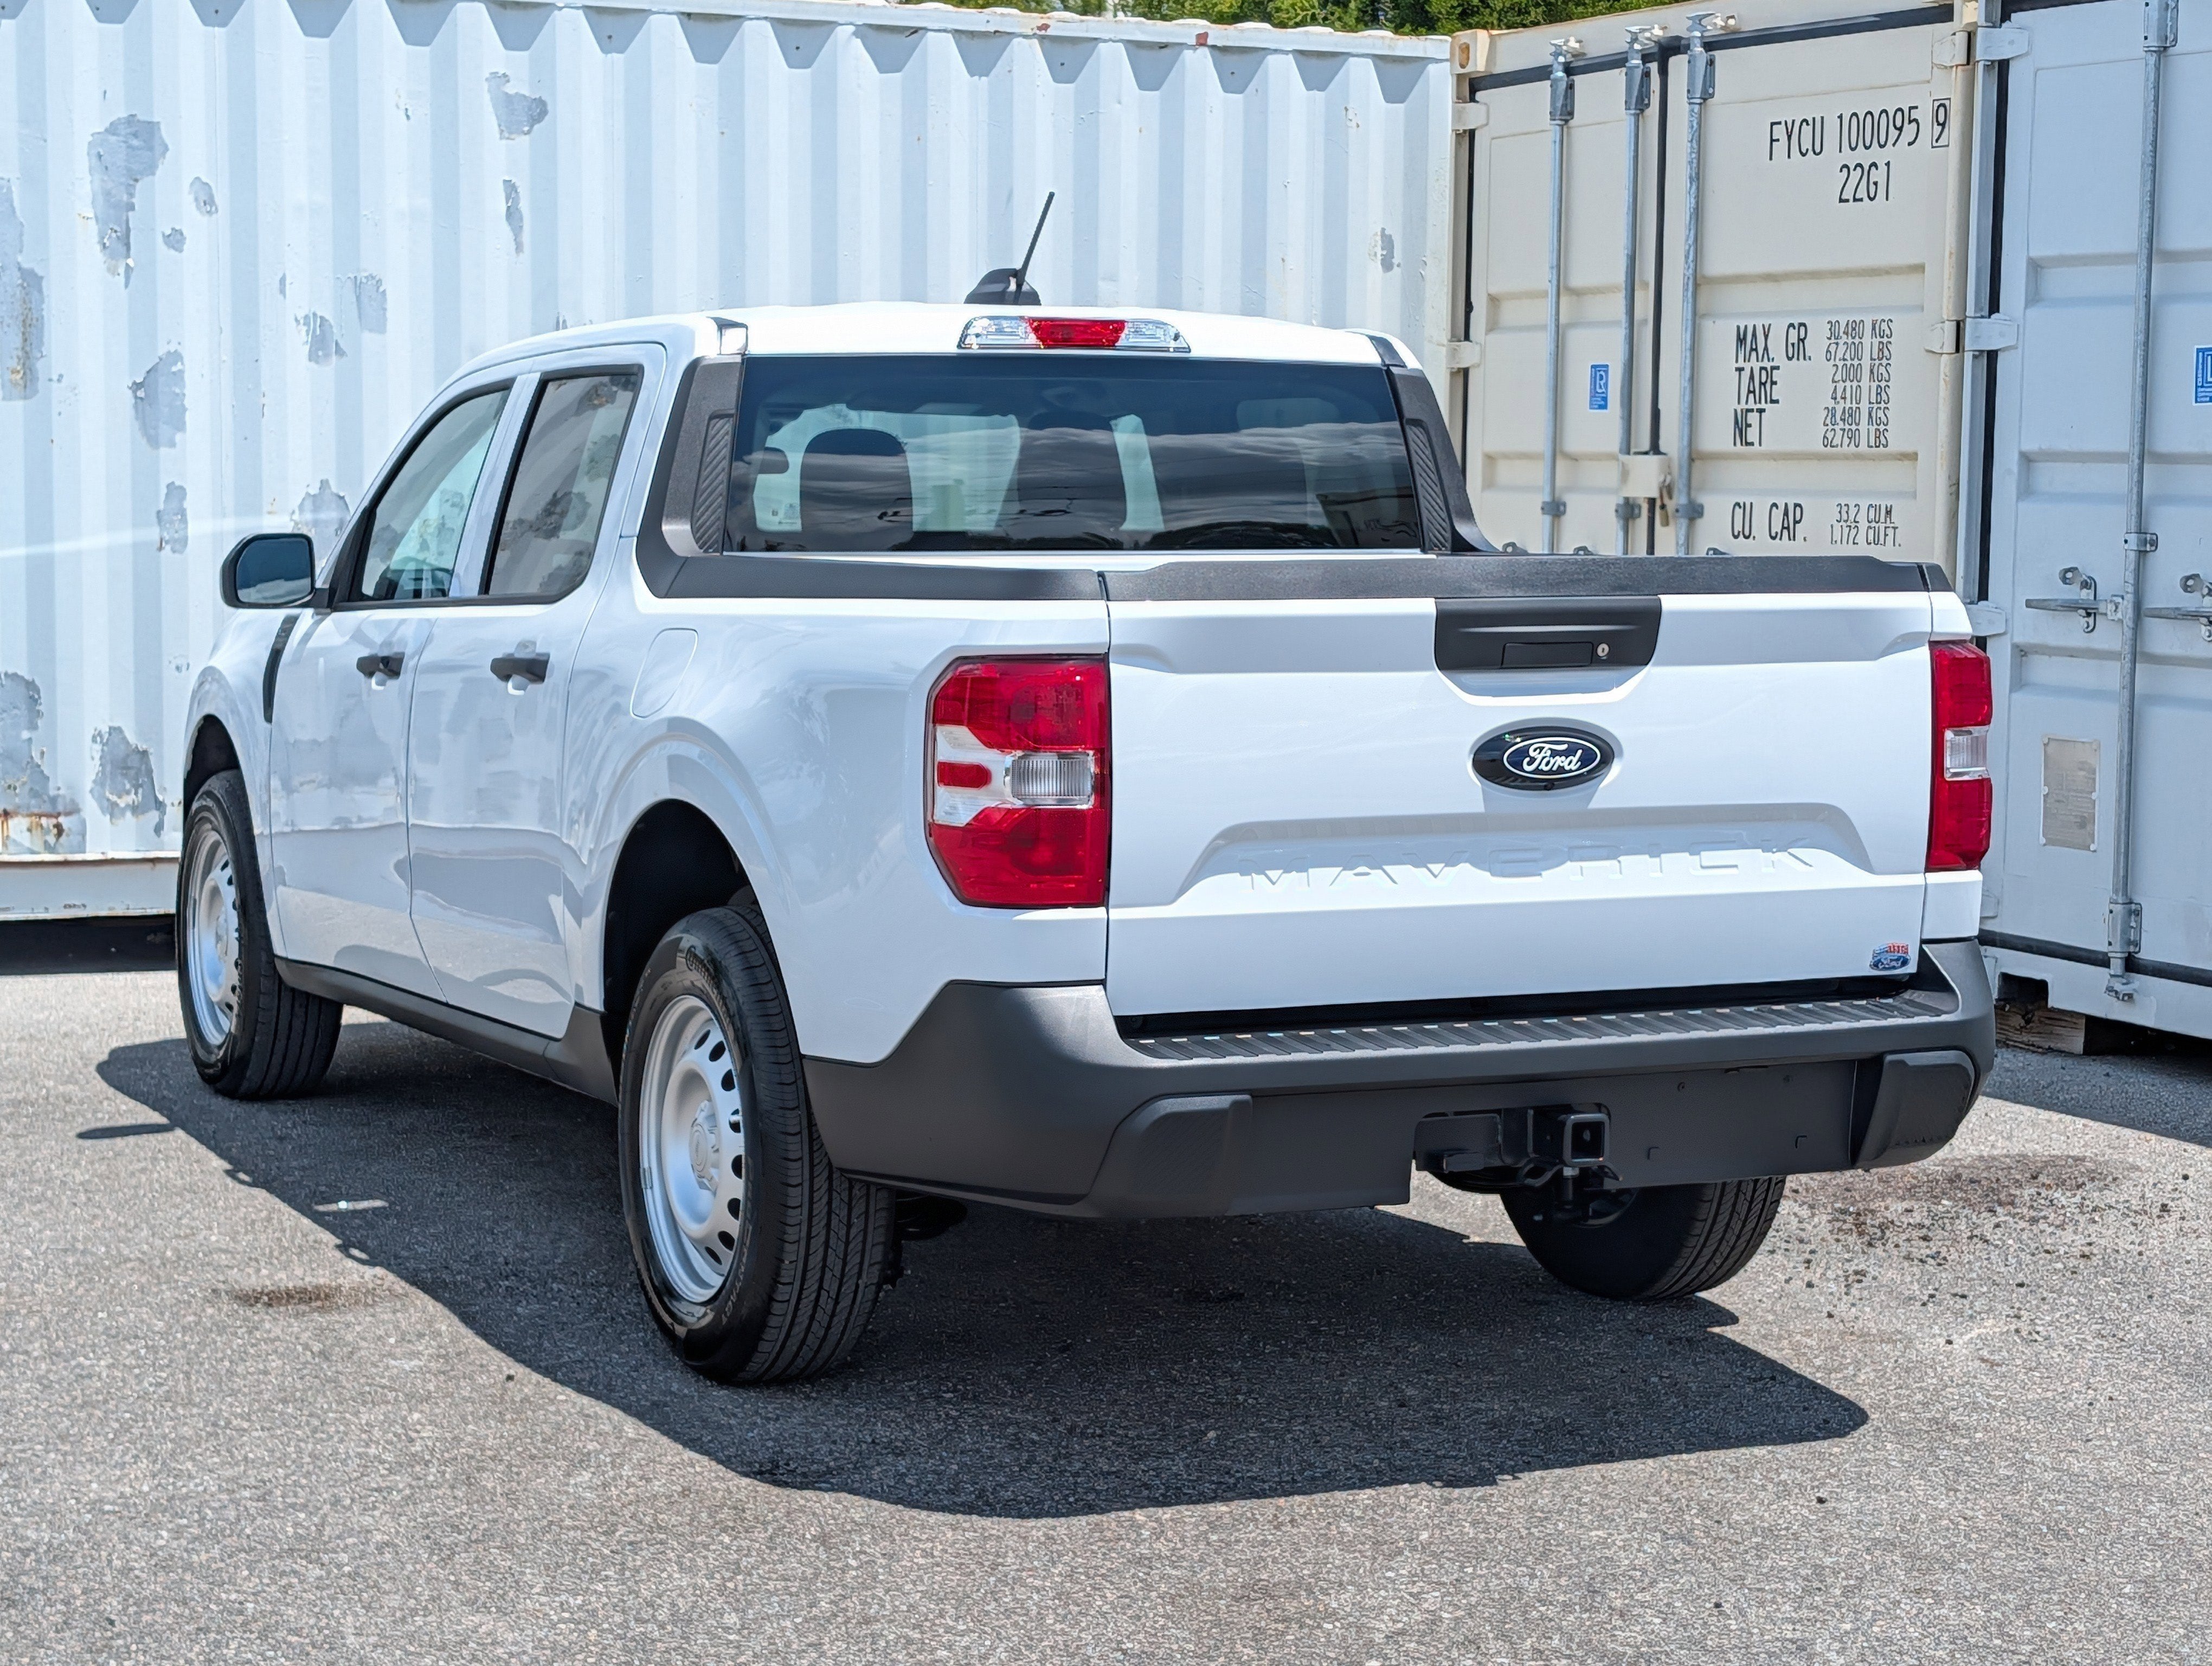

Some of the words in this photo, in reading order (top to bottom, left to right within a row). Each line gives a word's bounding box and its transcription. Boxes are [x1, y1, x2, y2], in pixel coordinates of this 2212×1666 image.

[1769, 116, 1824, 161] FYCU
[1837, 105, 1920, 153] 100095
[1935, 102, 1948, 143] 9
[1838, 161, 1891, 203] 22G1
[1735, 323, 1774, 363] MAX.
[1785, 322, 1812, 362] GR.
[1870, 318, 1894, 339] KGS
[1870, 341, 1892, 362] LBS
[1734, 365, 1780, 405] TARE
[1869, 362, 1892, 383] KGS
[1868, 384, 1891, 405] LBS
[1733, 408, 1766, 447] NET
[1867, 406, 1890, 427] KGS
[1867, 428, 1889, 448] LBS
[1731, 502, 1756, 541] CU.
[1768, 502, 1807, 542] CAP.
[1836, 503, 1860, 523] 33.2
[1522, 743, 1582, 772] Ford
[1238, 837, 1815, 892] MAVERICK
